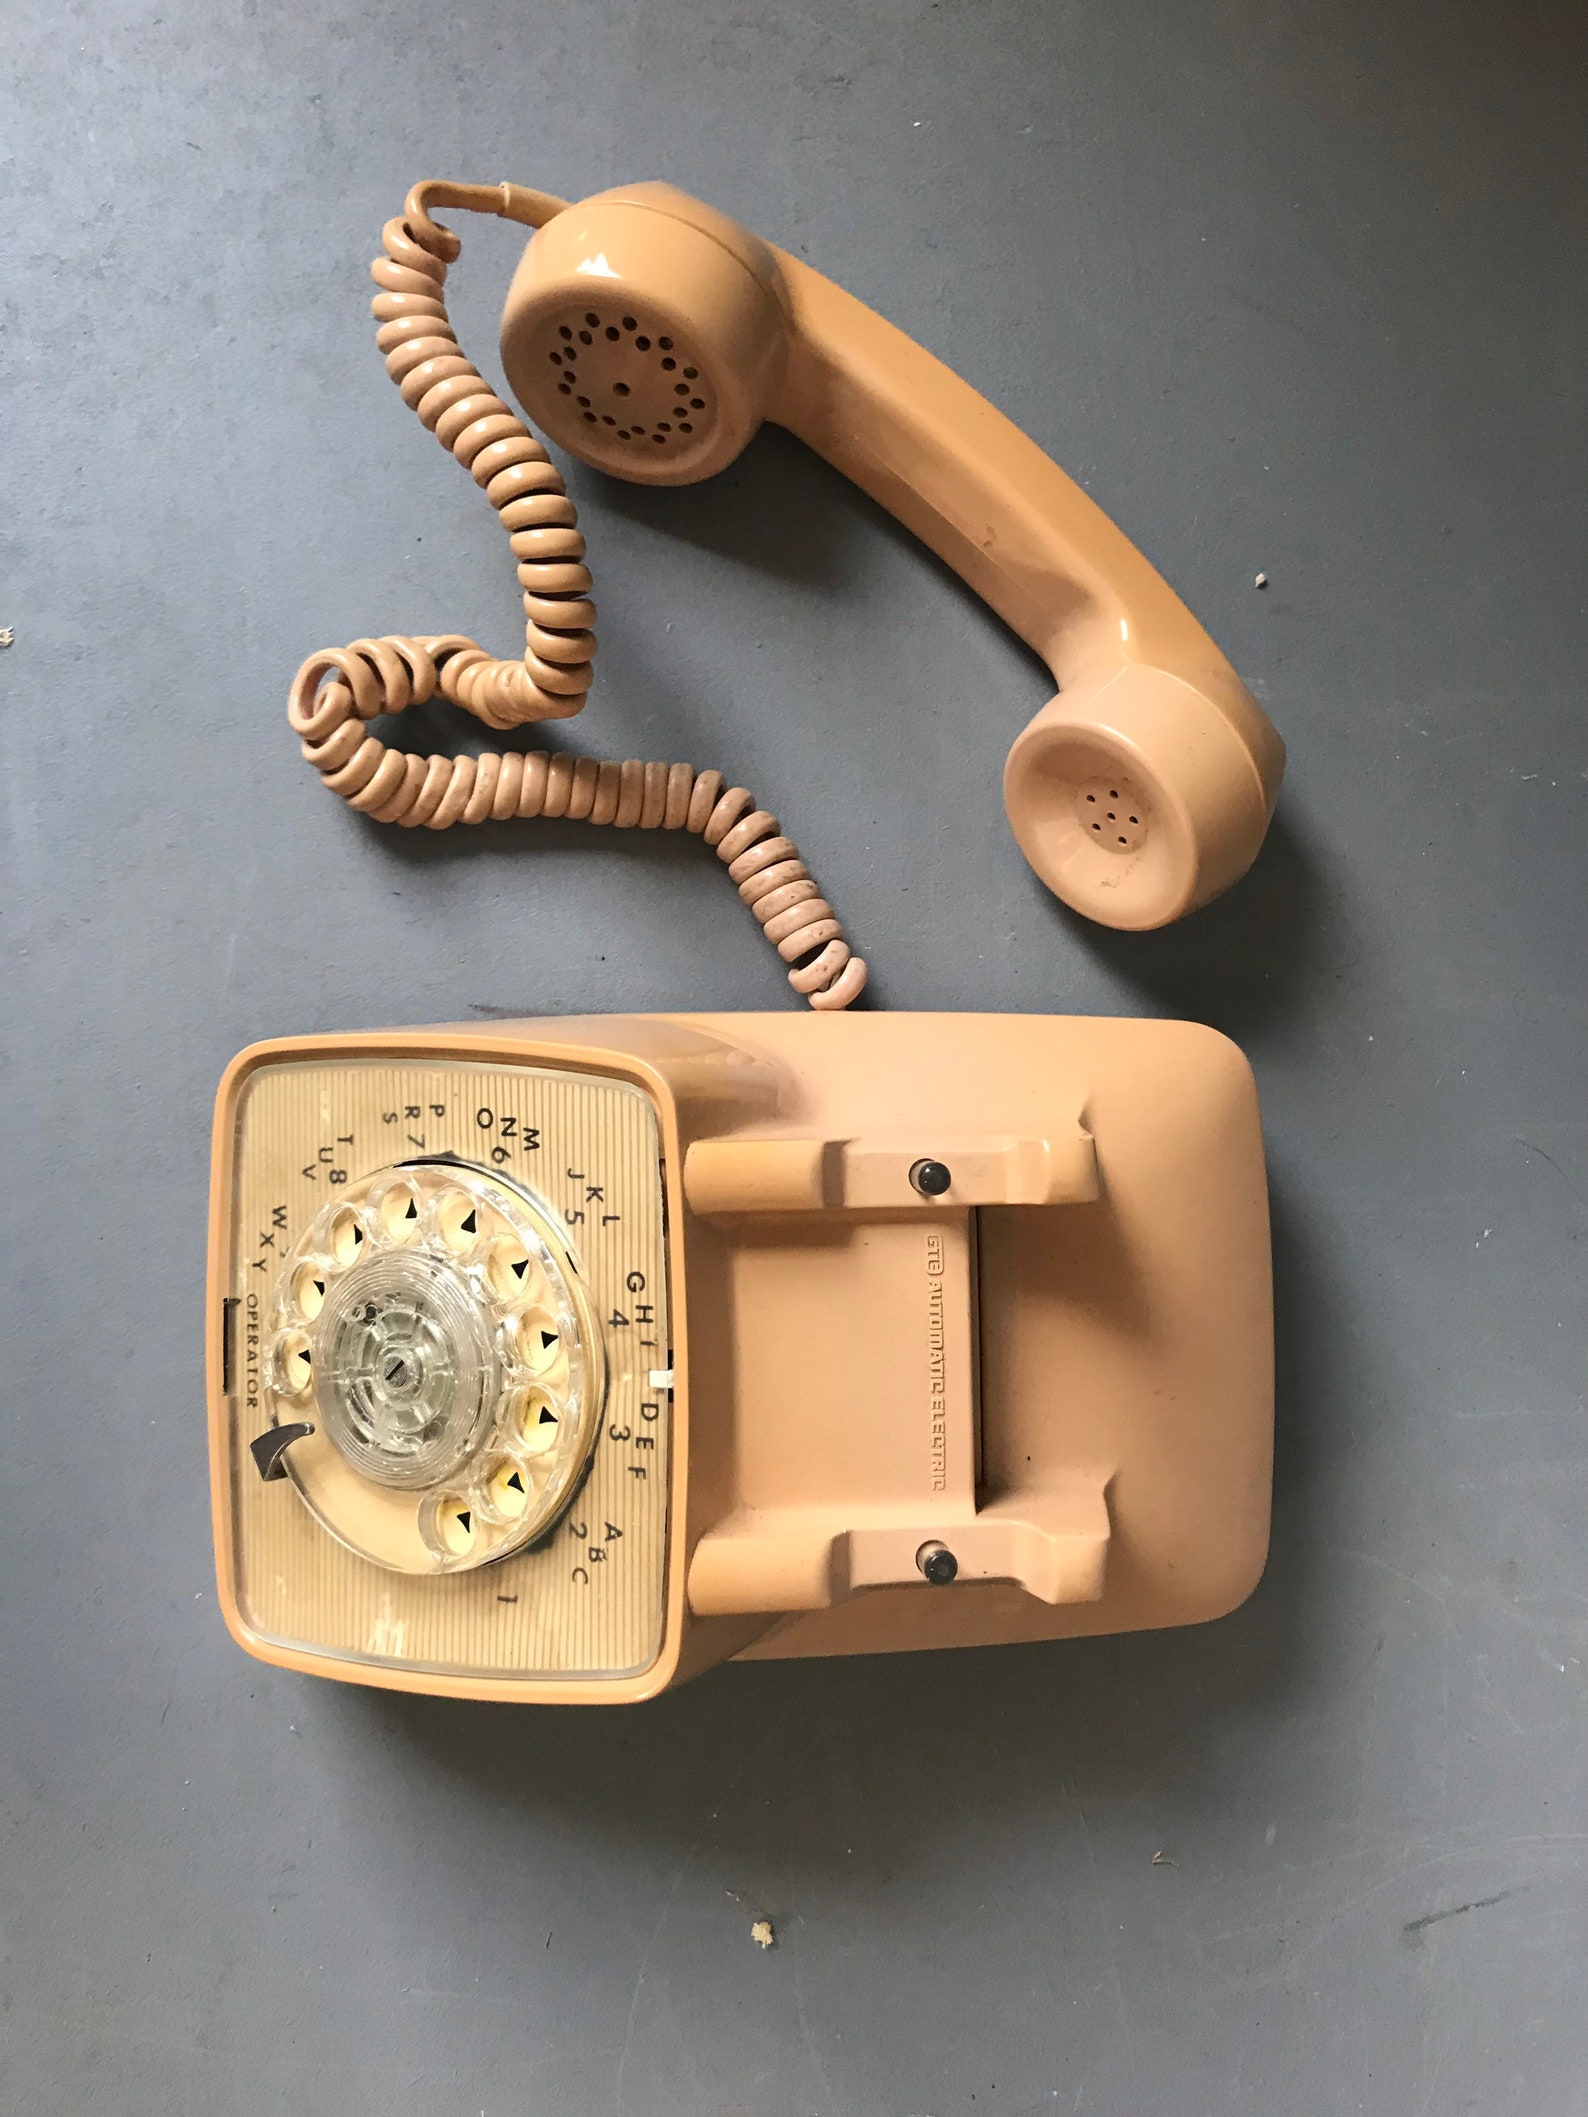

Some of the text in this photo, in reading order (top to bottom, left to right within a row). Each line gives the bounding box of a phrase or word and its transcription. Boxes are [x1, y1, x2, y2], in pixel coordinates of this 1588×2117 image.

[407, 1134, 425, 1149] 7
[491, 1146, 511, 1164] 6
[329, 1170, 347, 1184] 8
[565, 1209, 584, 1224] 5
[608, 1309, 629, 1328] 4
[246, 1293, 258, 1408] OPERATOR
[928, 1235, 946, 1491] GTE AUTOMATIC ELECTRIC
[609, 1424, 630, 1441] 3
[568, 1522, 588, 1540] 2
